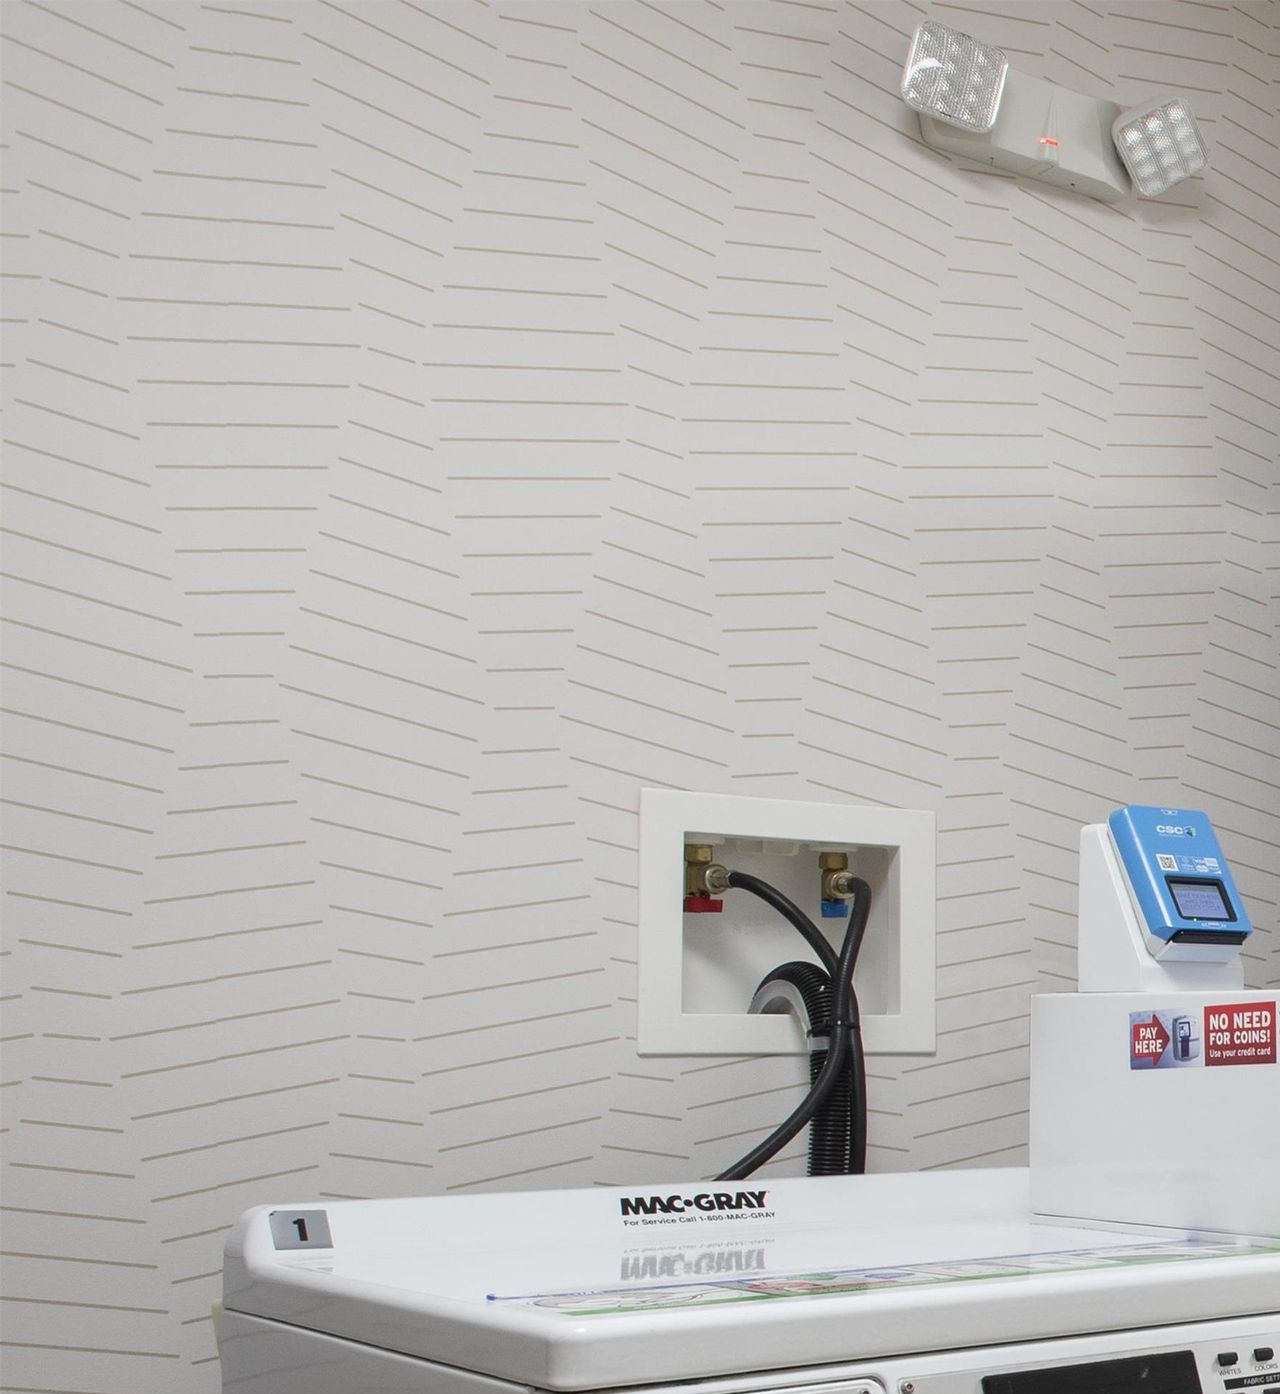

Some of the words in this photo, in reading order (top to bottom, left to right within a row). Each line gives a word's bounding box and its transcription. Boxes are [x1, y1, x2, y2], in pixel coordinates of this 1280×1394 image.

[1156, 825, 1184, 834] CSC
[1209, 1013, 1229, 1030] NO
[1233, 1010, 1271, 1029] NEED
[1139, 1026, 1158, 1040] PAY
[1209, 1031, 1230, 1046] FOR
[1233, 1029, 1271, 1044] COINS!
[1135, 1039, 1163, 1053] HERE
[1209, 1049, 1222, 1058] Use
[1222, 1049, 1237, 1059] your
[1237, 1047, 1256, 1057] credit
[1256, 1046, 1271, 1056] card
[623, 1219, 639, 1227] For
[641, 1217, 677, 1226] Service
[679, 1216, 697, 1224] Call
[699, 1211, 776, 1222] 1-800-MAC-GRAY
[292, 1218, 309, 1242] 1
[1218, 1368, 1242, 1376] WHITES
[1254, 1363, 1279, 1372] COLORS
[1244, 1376, 1264, 1385] FABRIC
